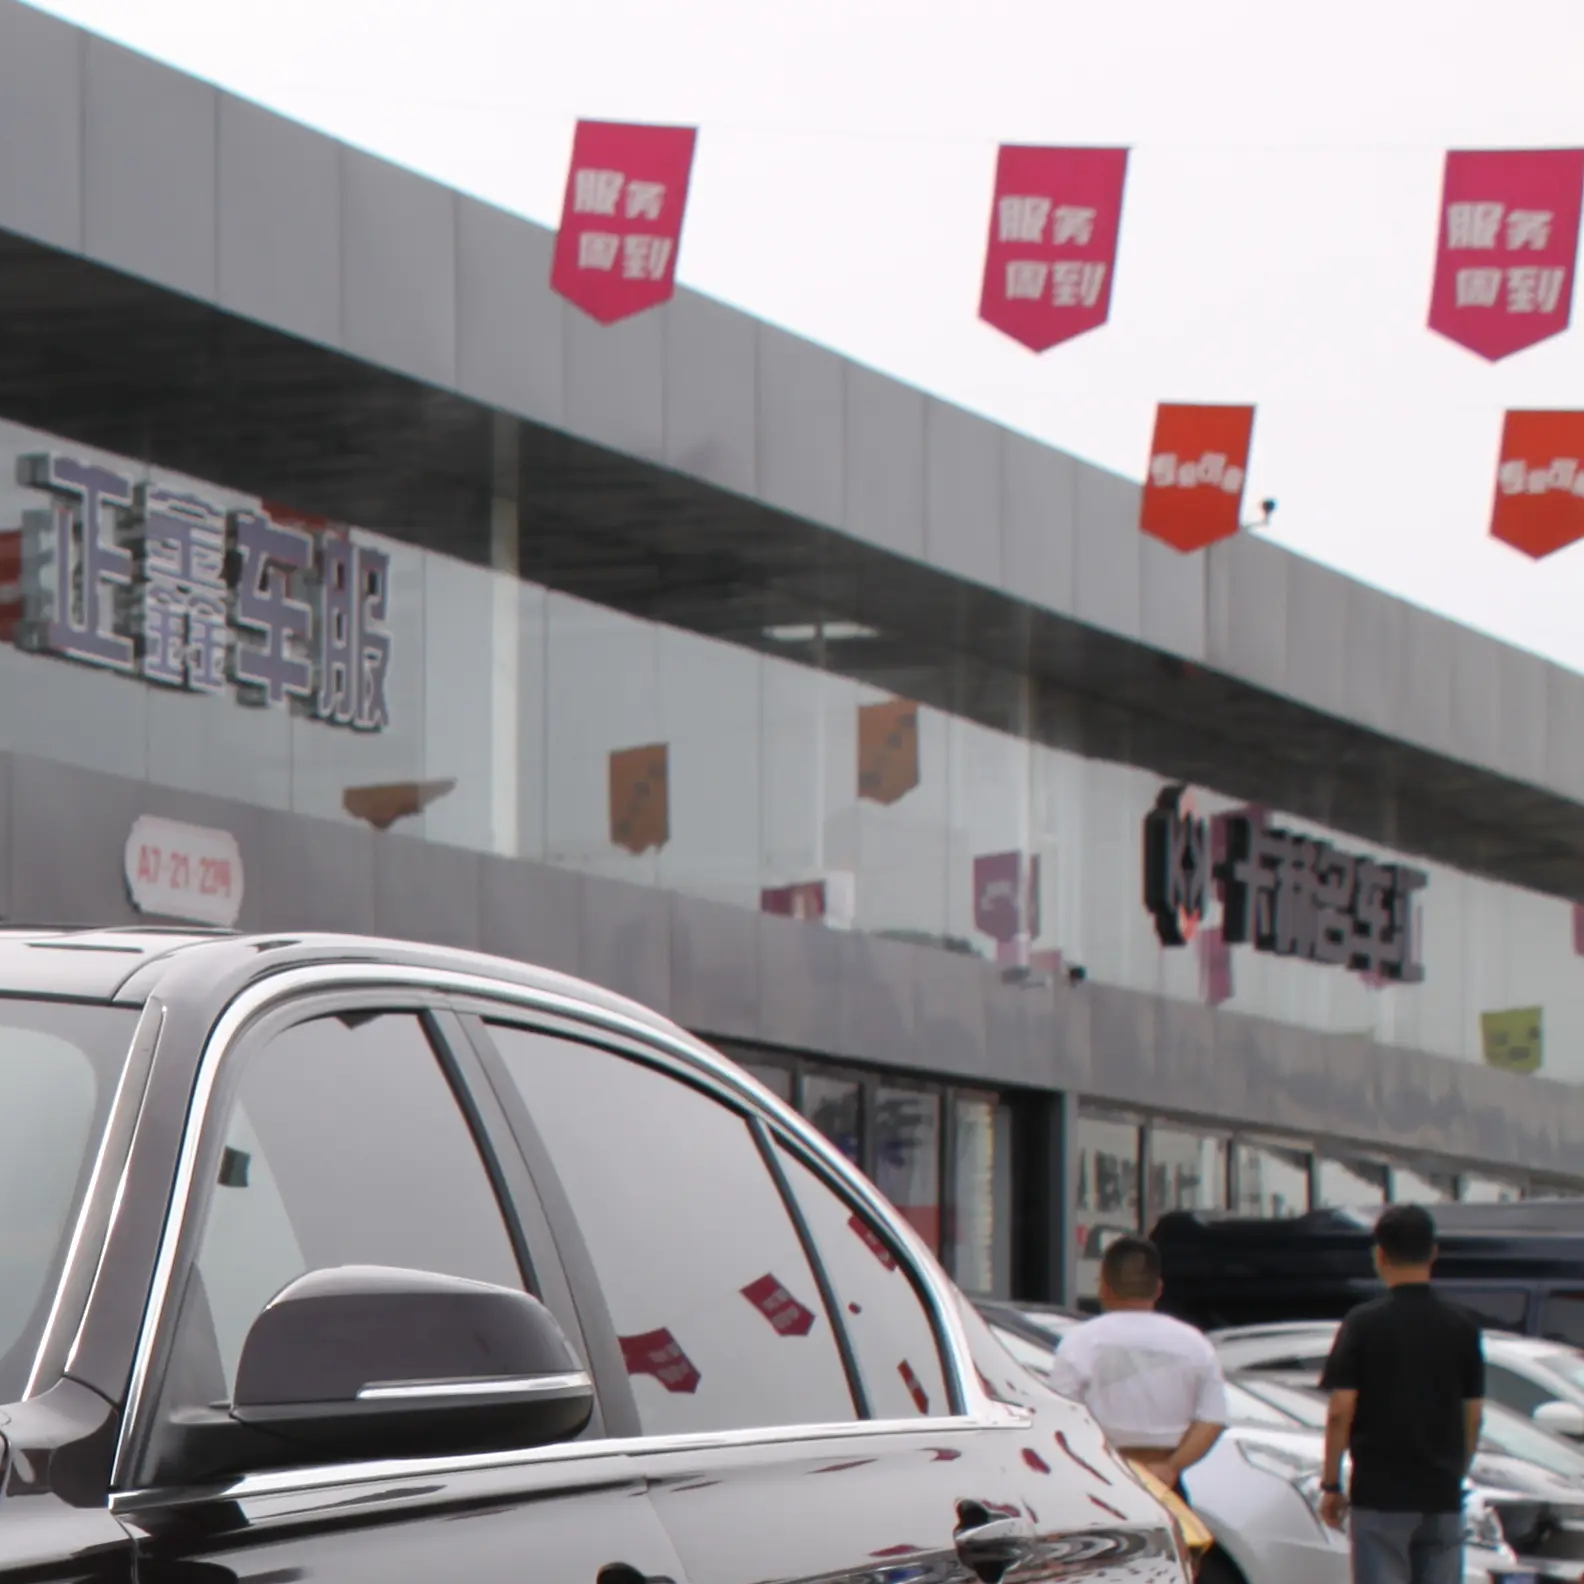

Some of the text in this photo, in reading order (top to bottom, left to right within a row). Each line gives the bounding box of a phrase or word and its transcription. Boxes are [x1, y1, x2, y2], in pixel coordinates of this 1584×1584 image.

[573, 169, 667, 221] 服务
[998, 195, 1096, 248] 服务
[1446, 202, 1554, 251] 服务
